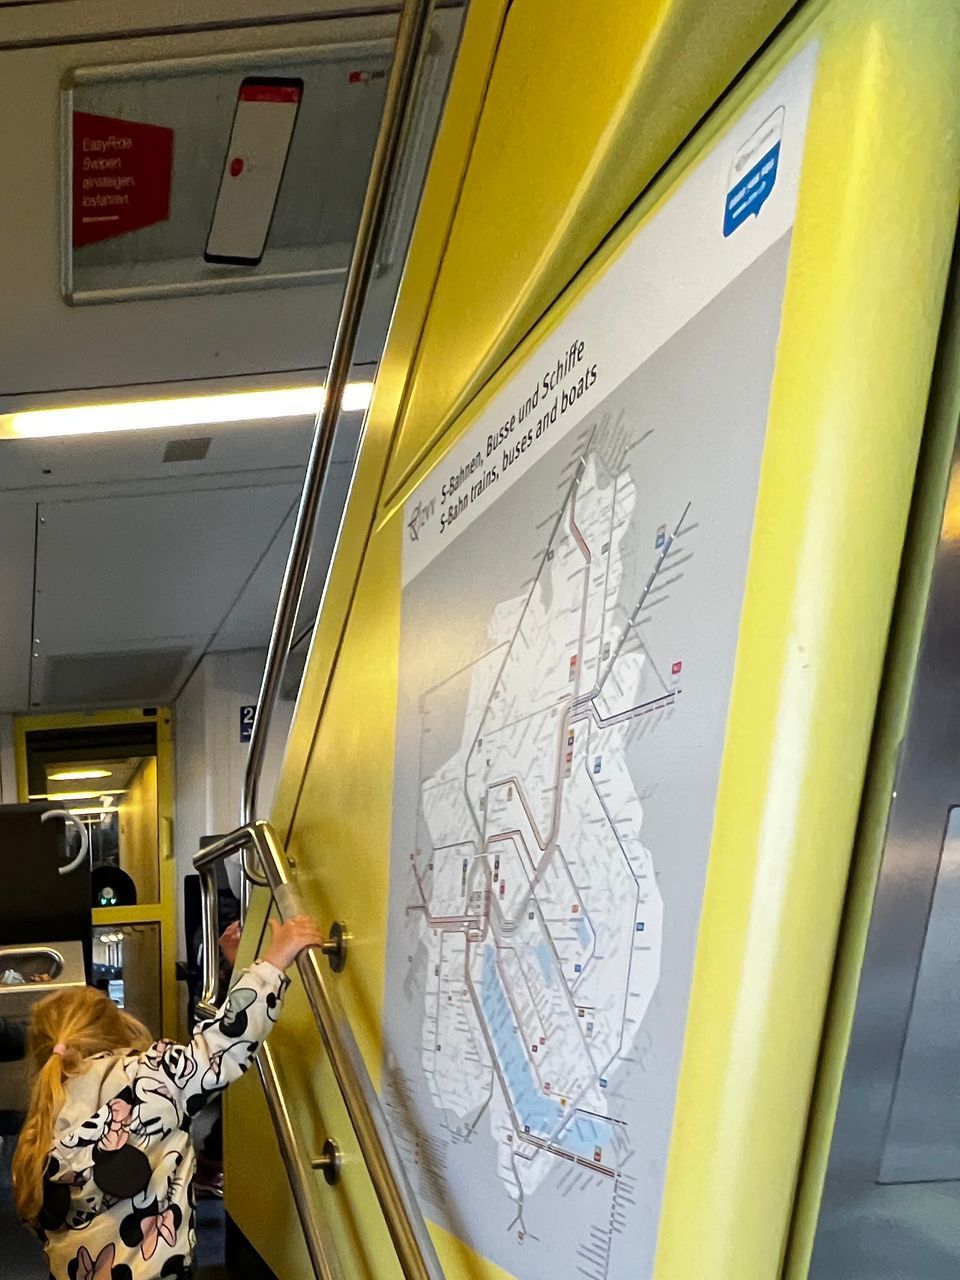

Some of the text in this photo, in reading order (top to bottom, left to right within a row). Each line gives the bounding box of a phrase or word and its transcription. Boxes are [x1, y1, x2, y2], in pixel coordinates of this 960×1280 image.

[440, 363, 598, 534] S-Bahn trains, buses and boats
[441, 339, 585, 504] S-Bahnen, Busse und Schiffe
[243, 707, 254, 723] 2
